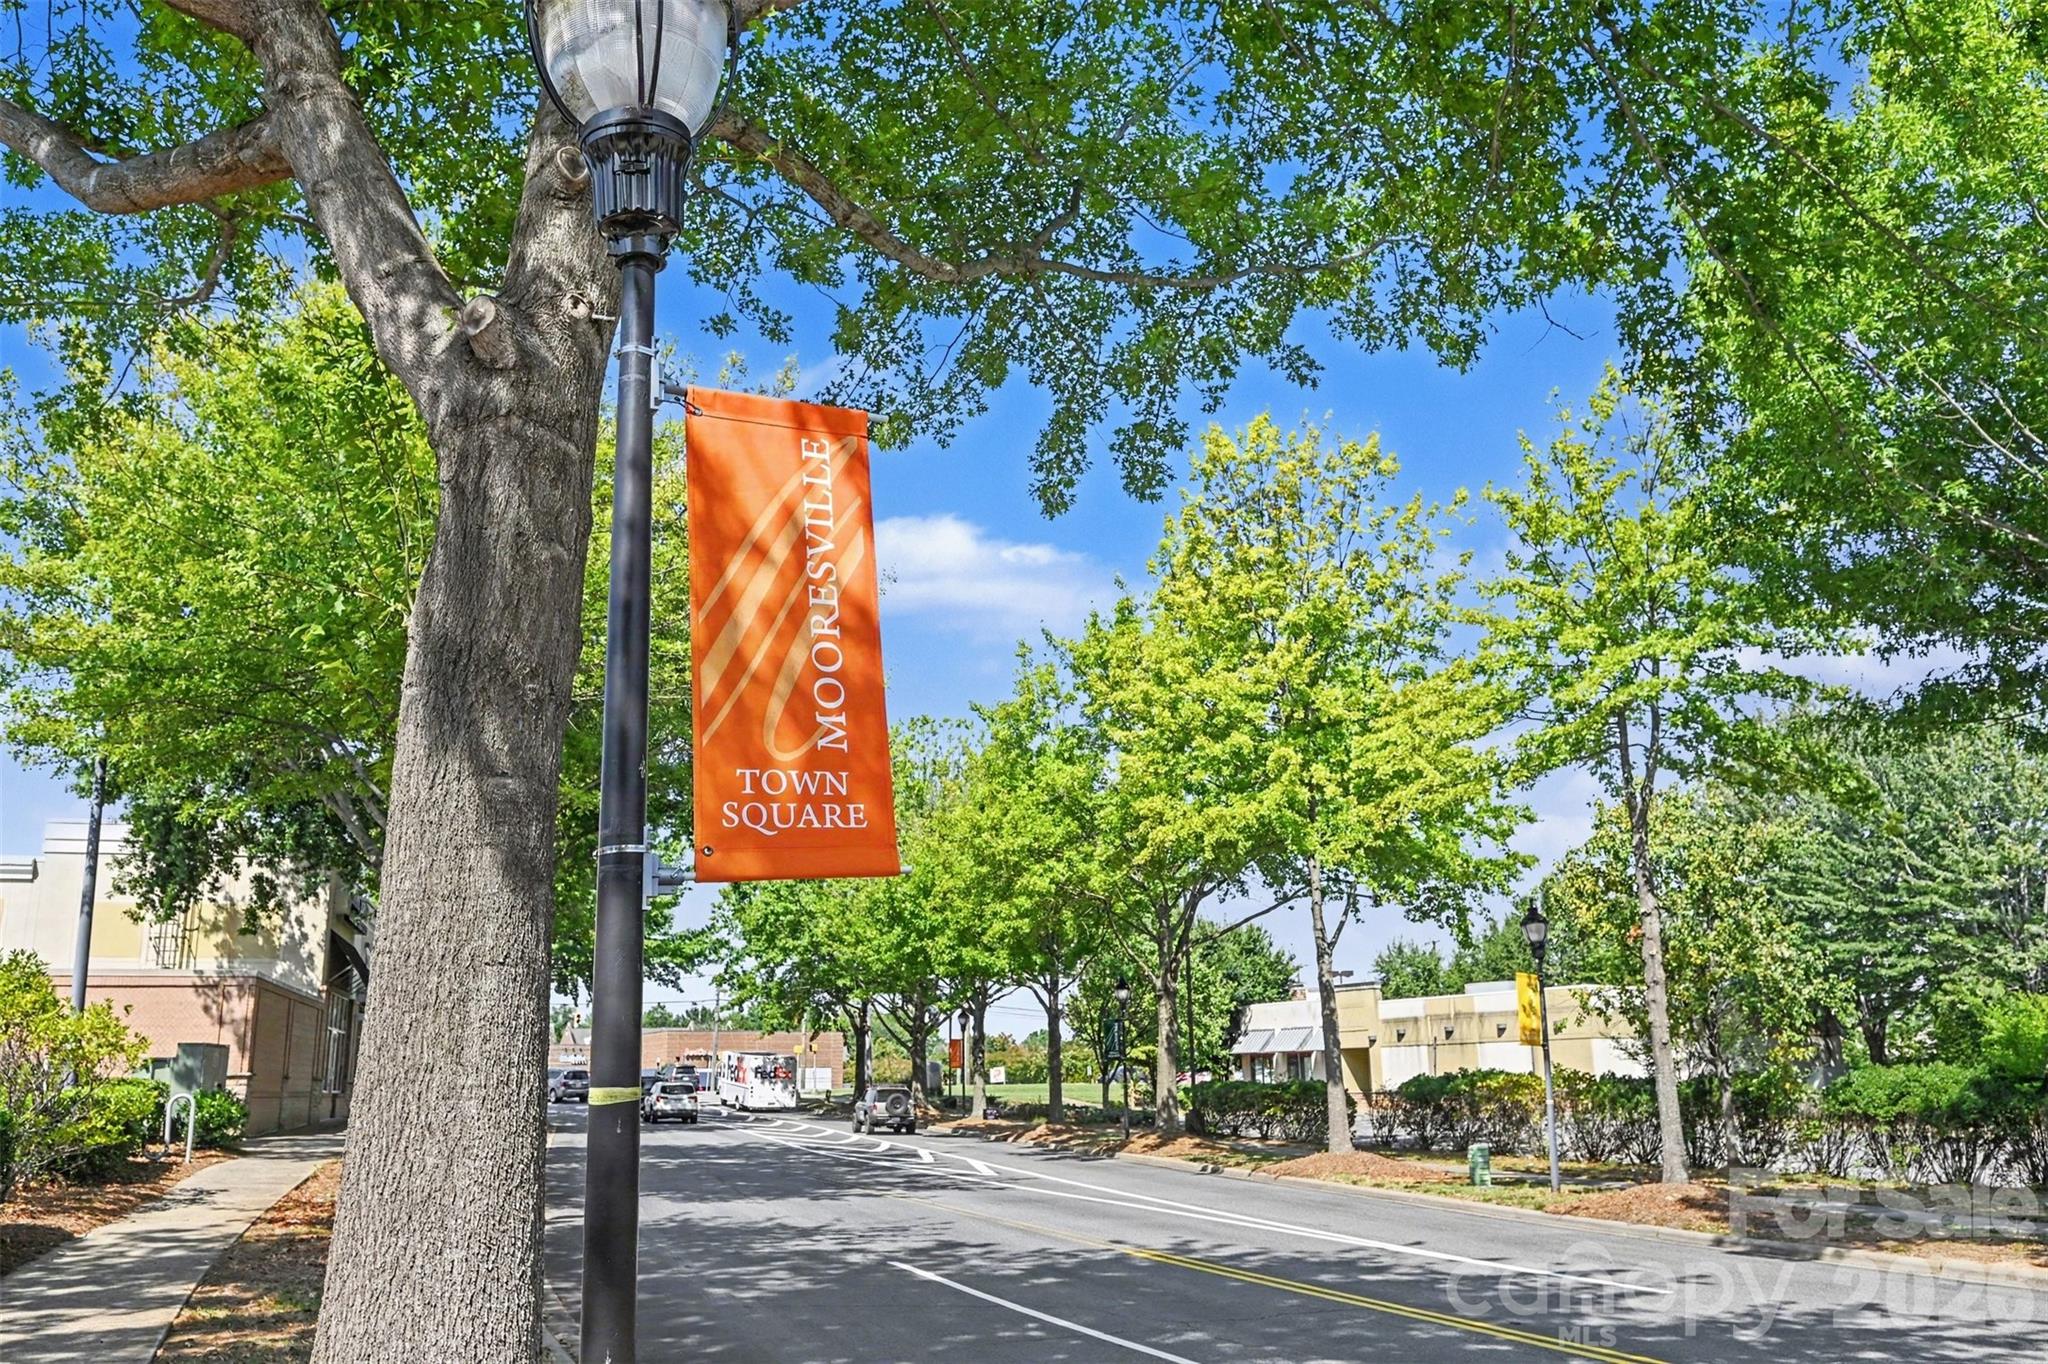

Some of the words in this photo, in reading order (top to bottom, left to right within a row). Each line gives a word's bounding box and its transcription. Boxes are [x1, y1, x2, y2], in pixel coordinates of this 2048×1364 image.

[802, 439, 848, 752] MOORESVILLE
[736, 768, 849, 796] TOWN
[721, 801, 868, 836] SQUARE
[755, 1064, 792, 1080] FedEx
